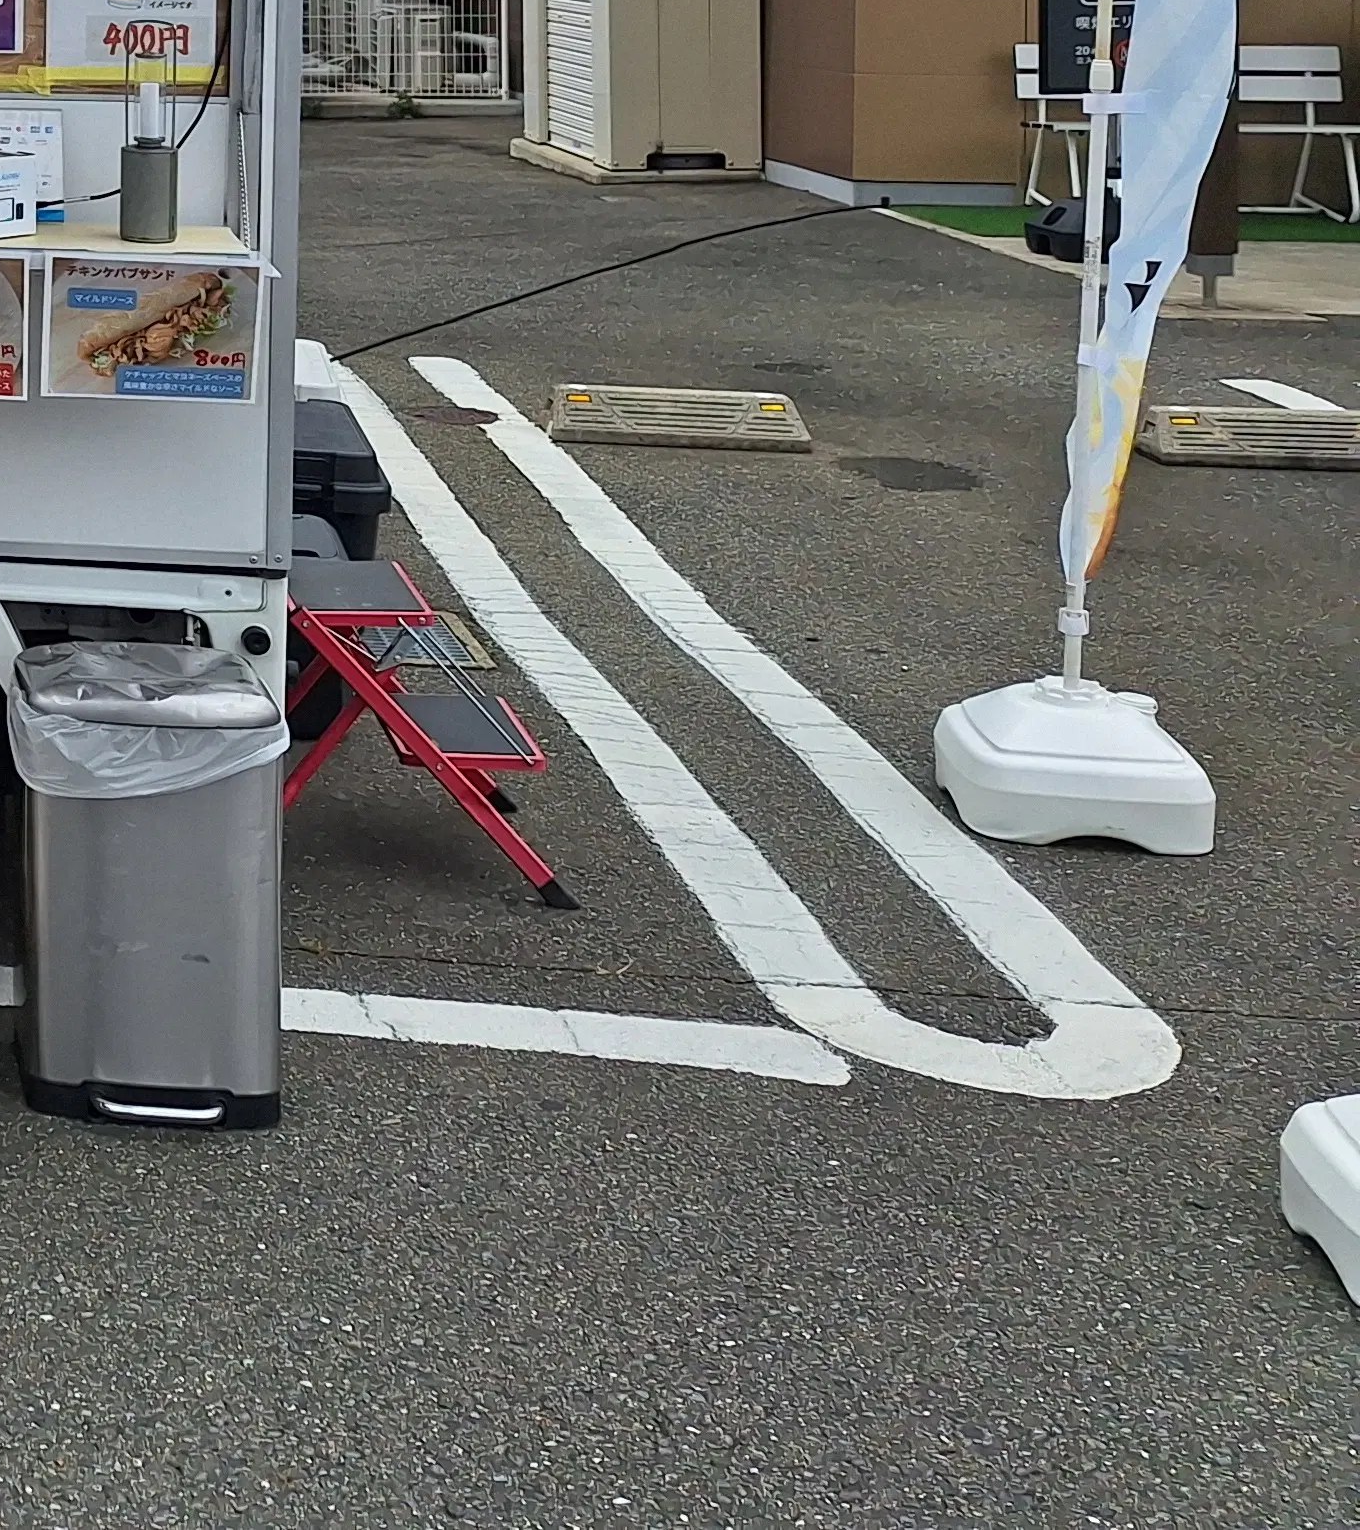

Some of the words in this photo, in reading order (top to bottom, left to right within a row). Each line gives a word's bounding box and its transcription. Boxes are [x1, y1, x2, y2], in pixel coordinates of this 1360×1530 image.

[103, 22, 191, 56] 400円
[74, 294, 134, 306] マイルドソース
